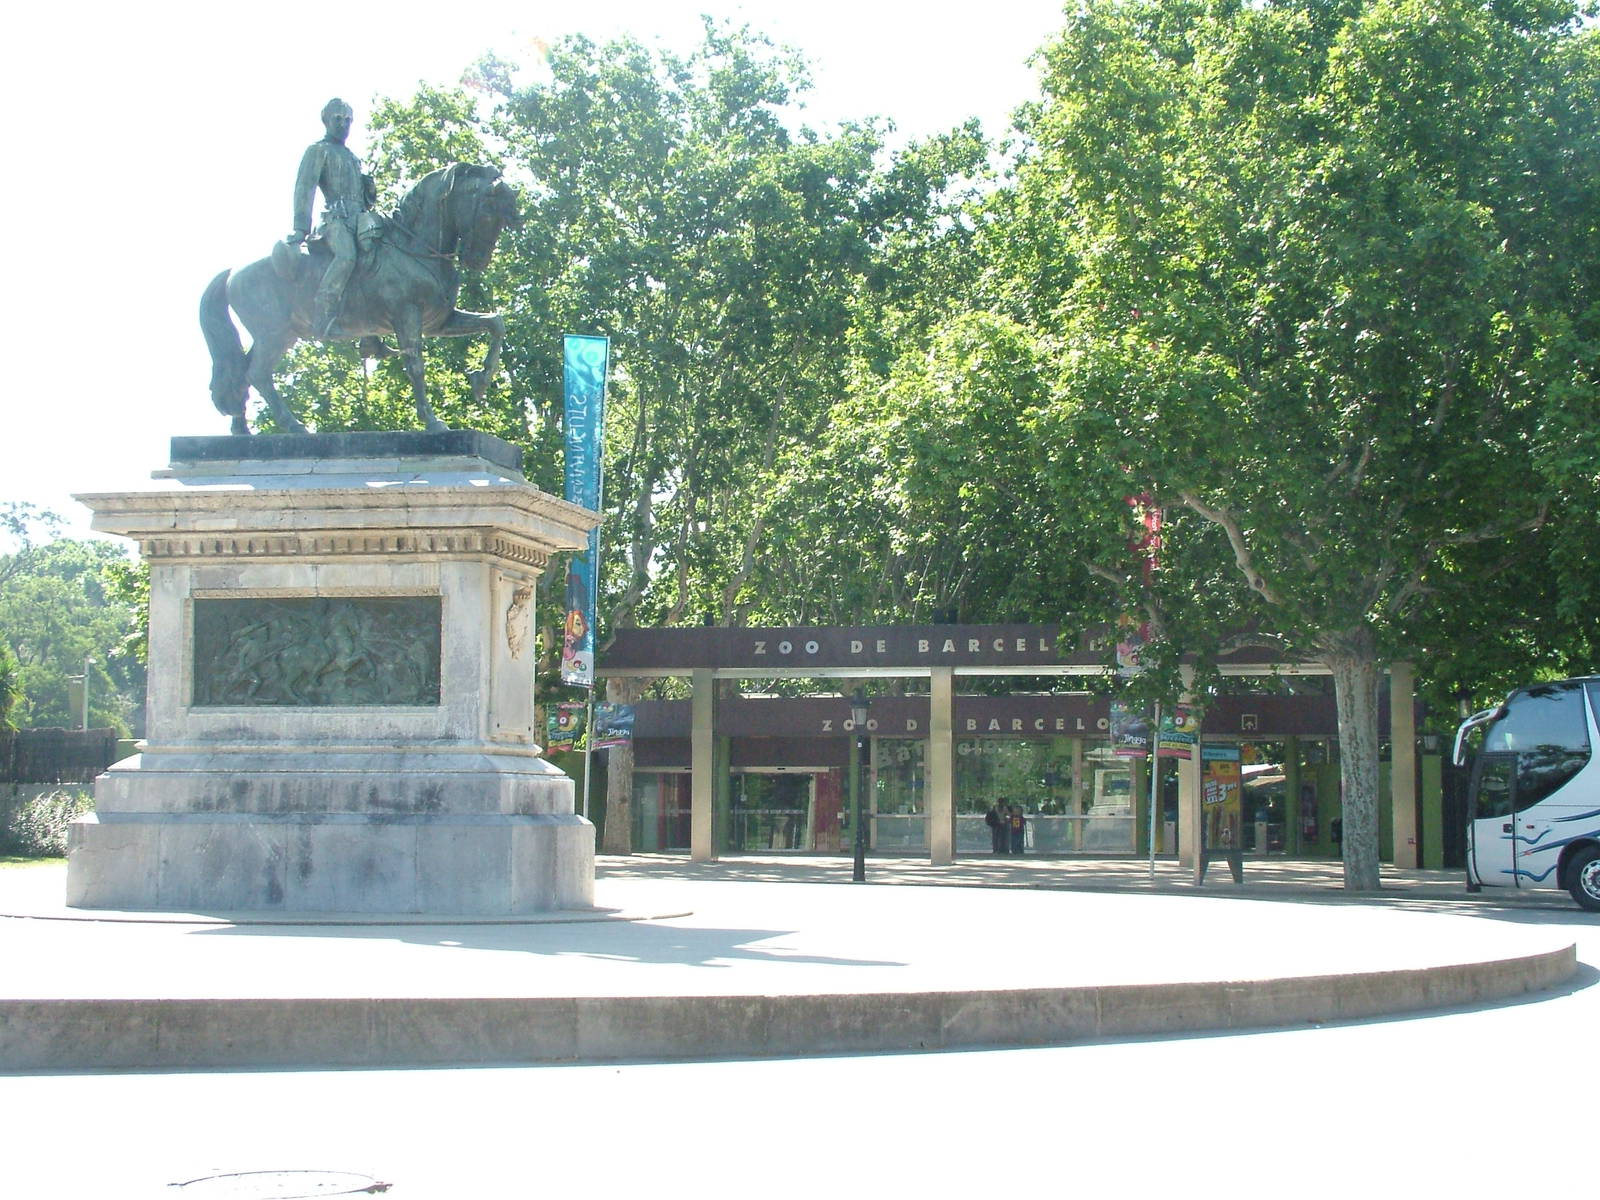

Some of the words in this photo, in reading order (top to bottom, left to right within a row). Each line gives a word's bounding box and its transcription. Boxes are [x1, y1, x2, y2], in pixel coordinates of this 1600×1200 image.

[754, 640, 819, 655] ZOO
[851, 640, 886, 653] DE
[918, 638, 1104, 653] BARCEL
[822, 719, 878, 731] ZOO
[966, 718, 1110, 731] BARCELO
